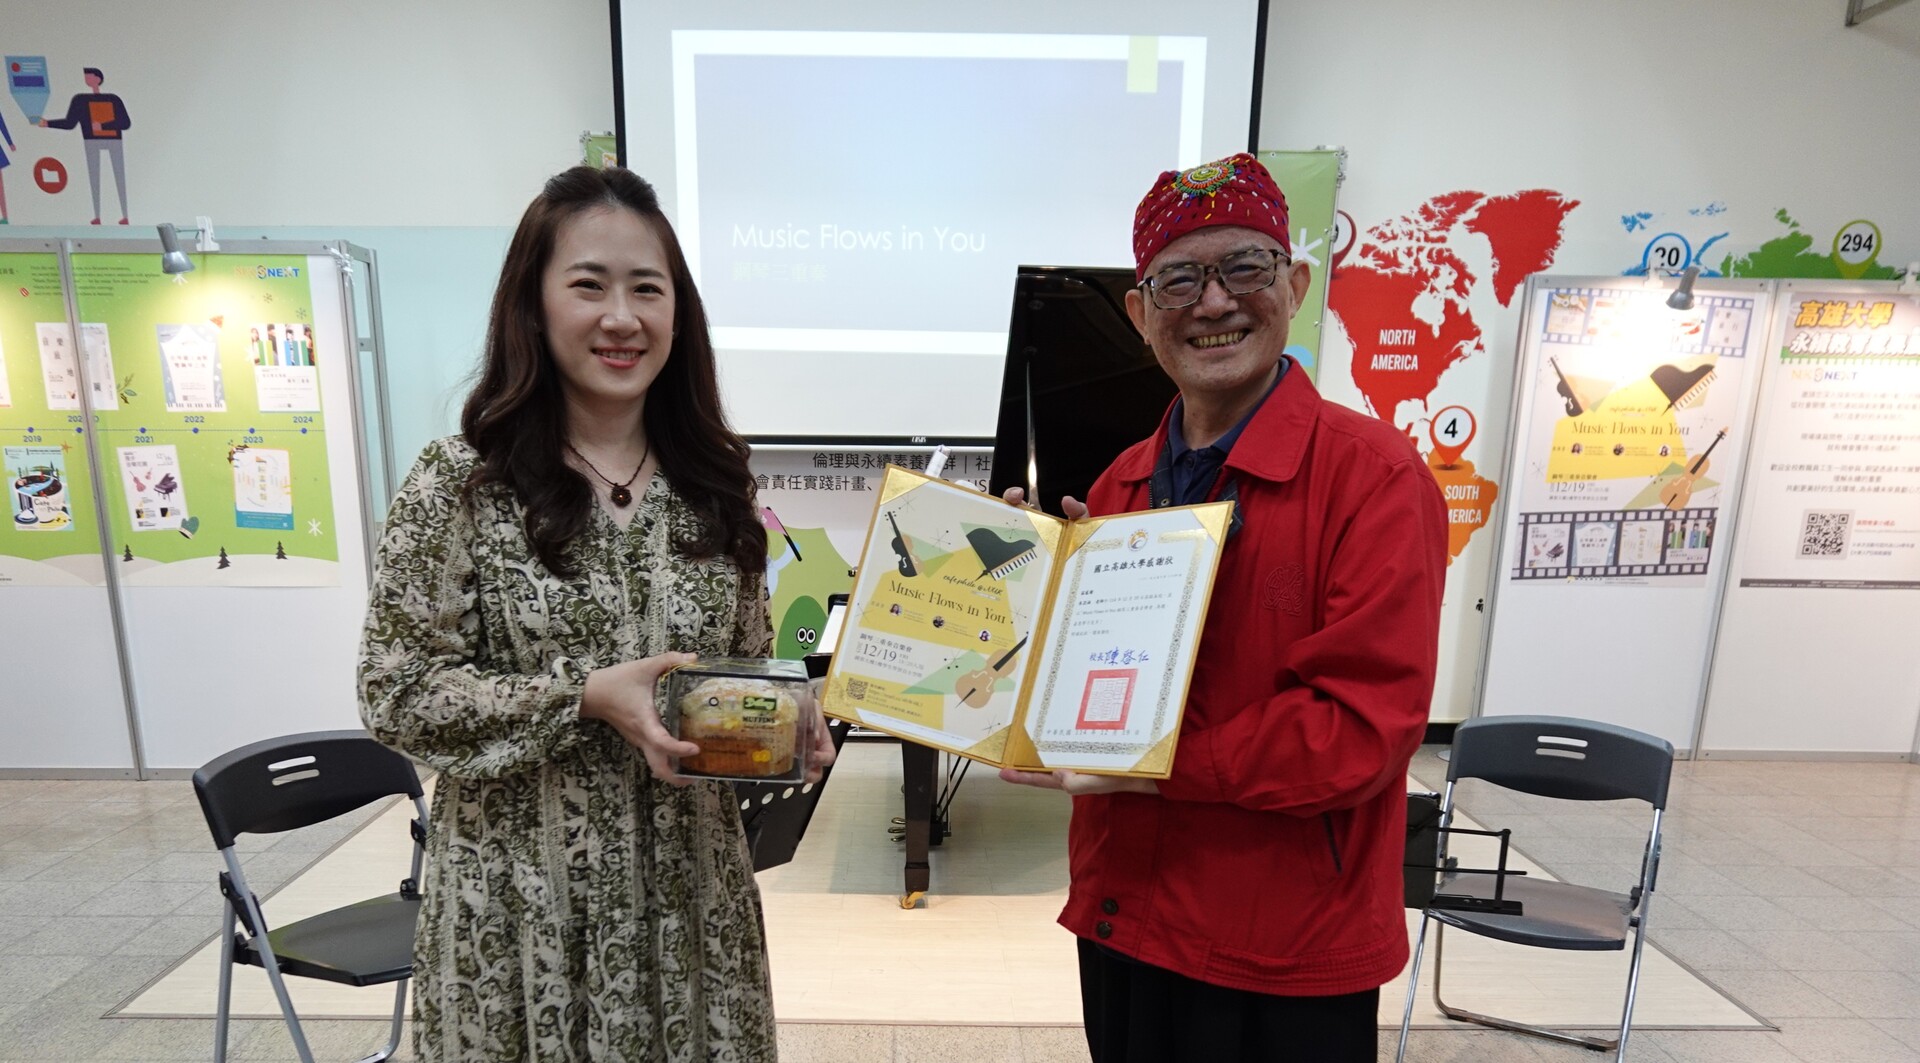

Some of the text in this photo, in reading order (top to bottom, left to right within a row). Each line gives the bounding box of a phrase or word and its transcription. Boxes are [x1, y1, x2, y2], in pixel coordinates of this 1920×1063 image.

[732, 223, 986, 252] Music Flows in You
[1840, 234, 1874, 253] 294
[1794, 300, 1896, 329] 高雄大學
[1379, 329, 1416, 346] NORTH
[1371, 354, 1419, 371] AMERICA
[184, 415, 205, 423] 2022
[293, 415, 313, 423] 2024
[1444, 418, 1458, 438] 4
[1572, 421, 1690, 436] Music Flows in You
[23, 435, 42, 443] 2019
[135, 435, 154, 443] 2021
[243, 436, 264, 444] 2023
[975, 456, 990, 471] 社
[1445, 485, 1480, 500] SOUTH
[1556, 481, 1586, 493] 12/19
[1448, 509, 1482, 524] MERICA
[1094, 556, 1174, 574] 國立高雄大學感謝狀
[889, 580, 926, 601] Music
[928, 591, 964, 613] Flows
[967, 604, 980, 617] in
[983, 607, 1006, 625] You
[863, 643, 897, 662] 12/19
